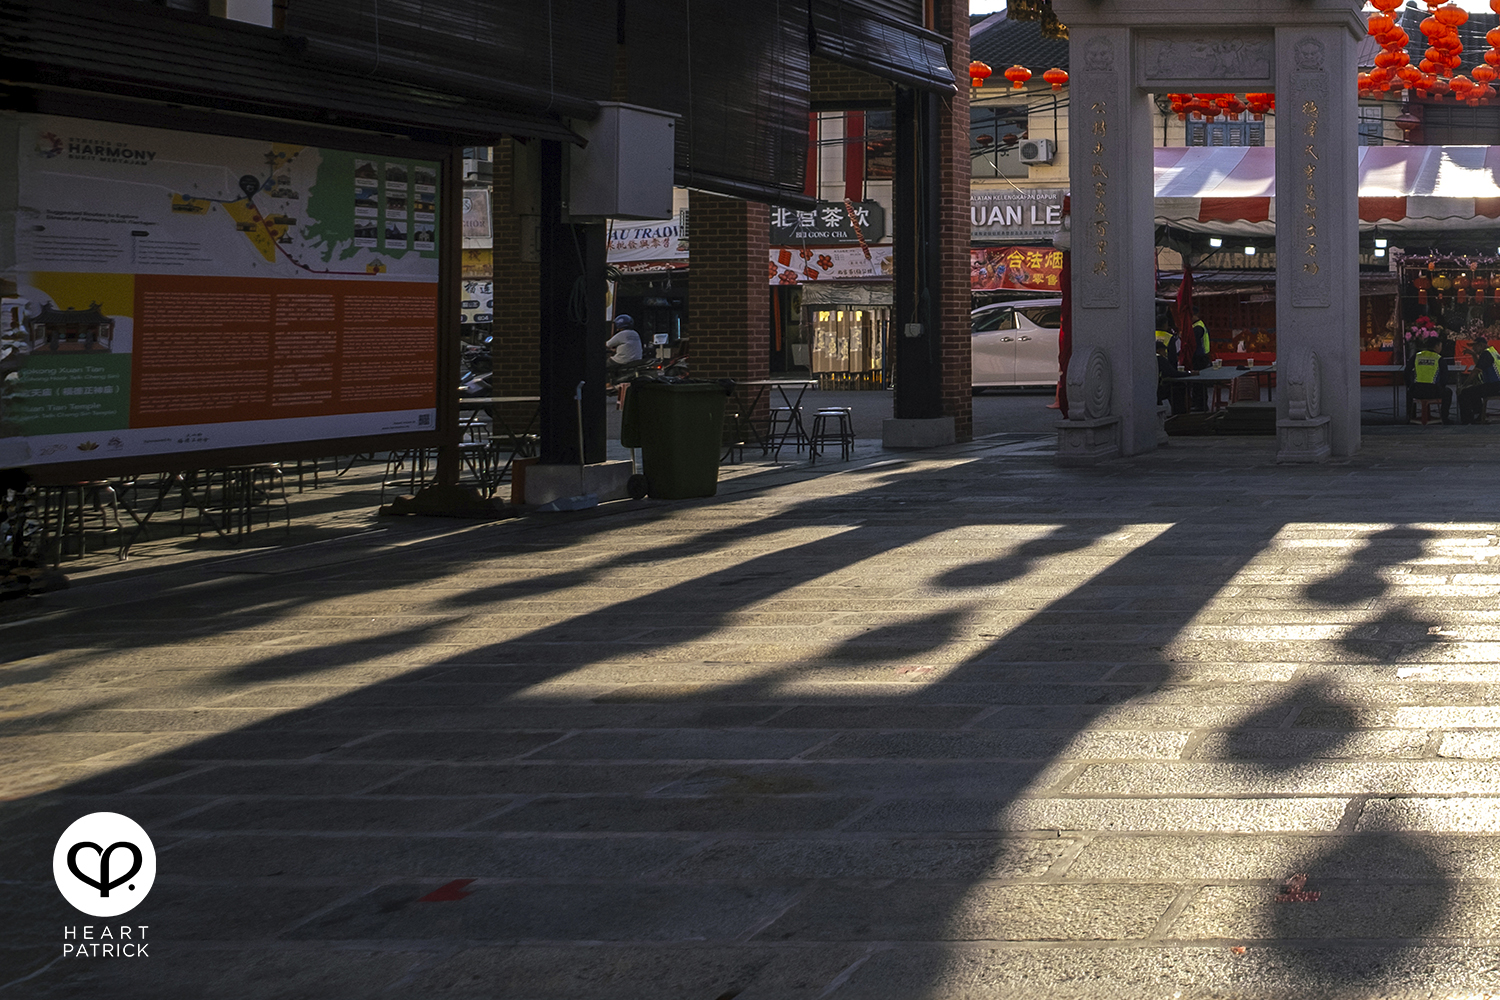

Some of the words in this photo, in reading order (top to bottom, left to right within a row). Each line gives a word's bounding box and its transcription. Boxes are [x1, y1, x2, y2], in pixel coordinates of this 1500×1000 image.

[68, 143, 156, 161] HARMONY
[970, 205, 1022, 226] UAN
[69, 402, 102, 411] Temple
